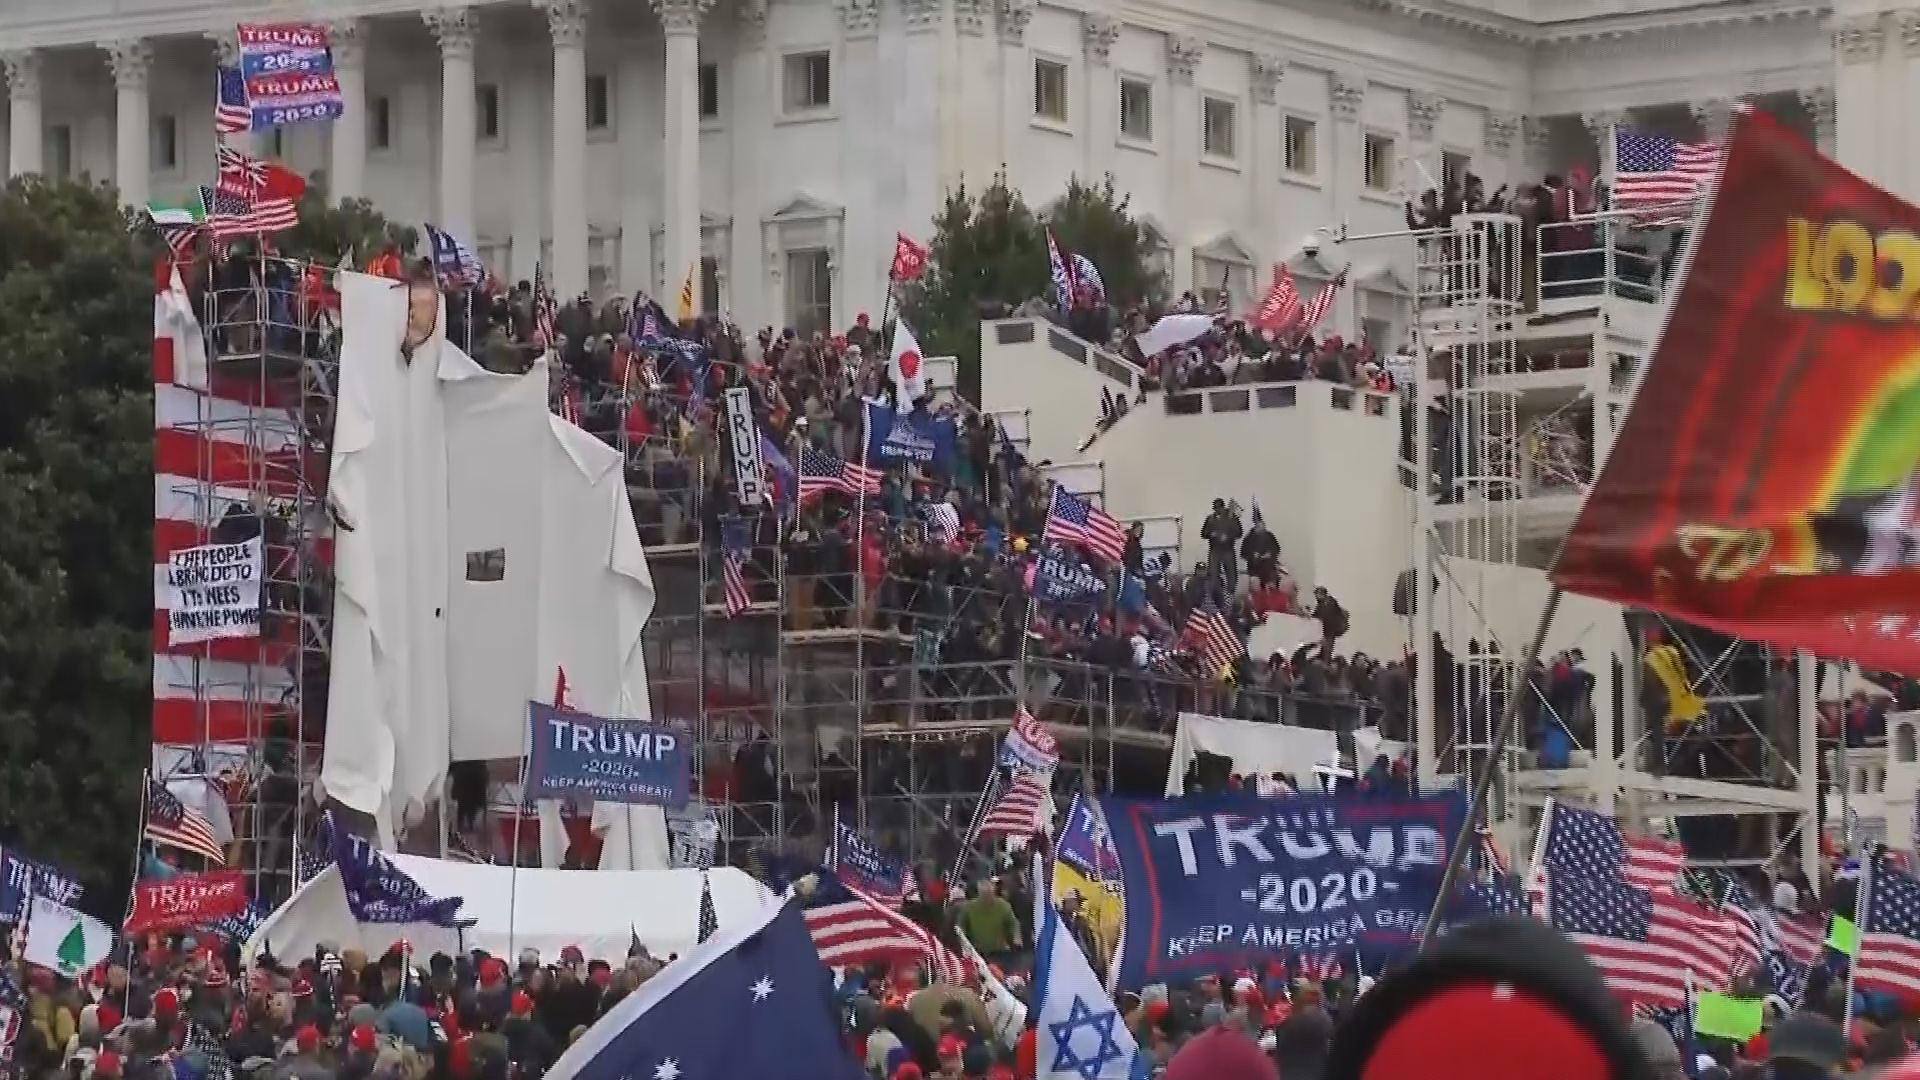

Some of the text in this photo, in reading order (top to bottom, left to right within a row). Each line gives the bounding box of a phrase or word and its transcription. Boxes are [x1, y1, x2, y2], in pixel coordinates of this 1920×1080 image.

[255, 78, 336, 95] TRUMP
[271, 103, 327, 123] 2020
[729, 391, 758, 503] TRUMP
[202, 543, 252, 566] PEOPLE
[210, 564, 232, 581] DC
[231, 563, 252, 580] TO
[549, 718, 677, 762] TRUMP
[541, 776, 575, 788] KEEP
[1153, 808, 1446, 877] TRUMP
[1241, 912, 1367, 948] AMERICA
